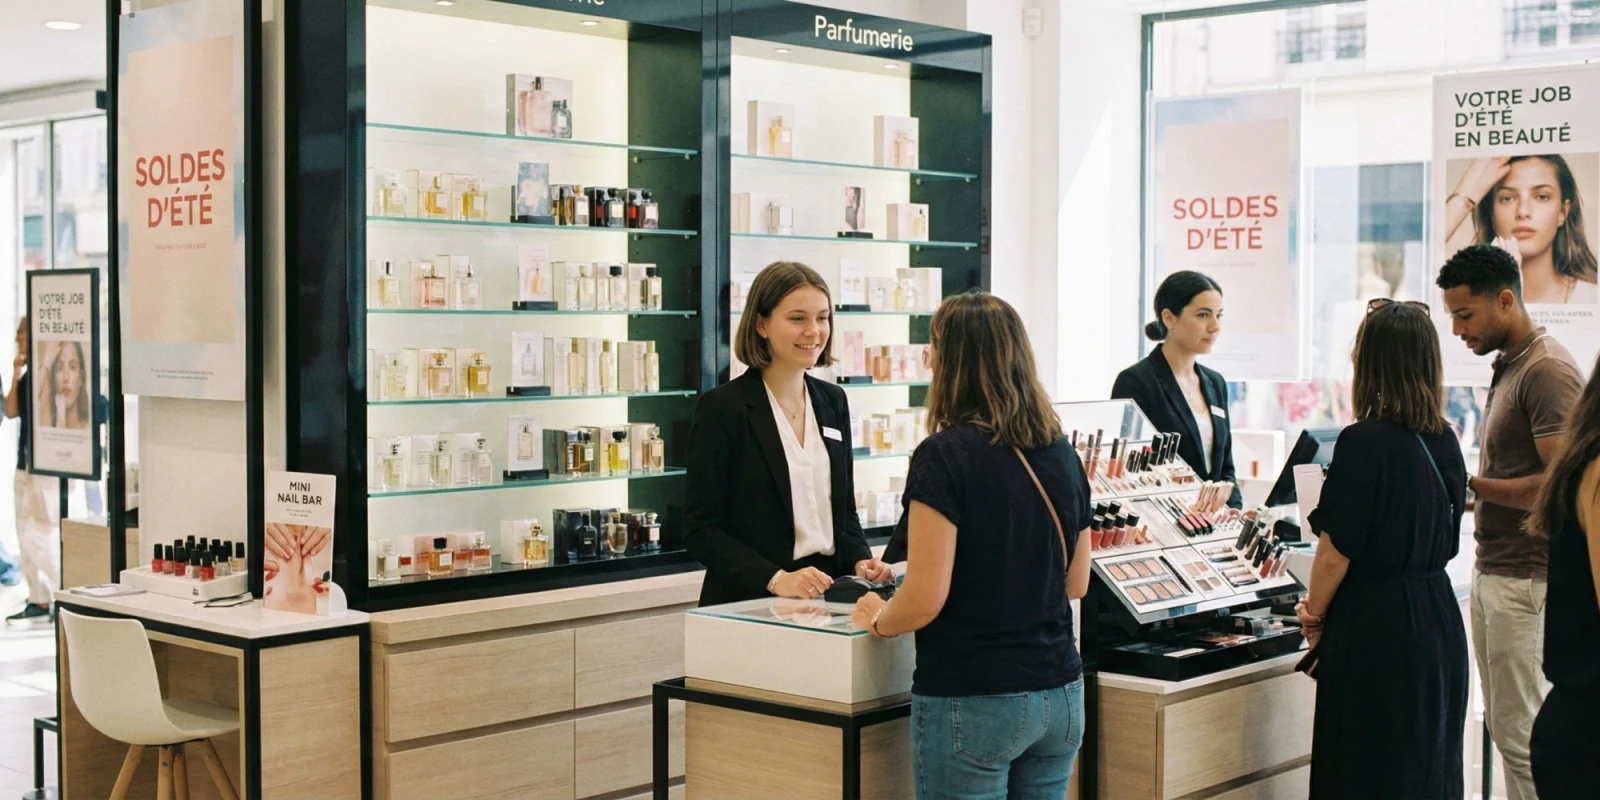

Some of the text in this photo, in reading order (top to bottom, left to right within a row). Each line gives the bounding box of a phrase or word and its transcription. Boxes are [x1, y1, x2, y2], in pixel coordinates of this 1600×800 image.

[815, 15, 913, 51] Parfumerie
[1455, 86, 1571, 108] VOTRE JOB
[1455, 106, 1512, 128] D'ÉTÉ
[1455, 122, 1571, 147] EN BEAUTÉ
[135, 148, 225, 187] SOLDES
[147, 184, 212, 228] D'ÉTÉ
[1173, 195, 1278, 220] SOLDES
[1187, 220, 1262, 250] D'ÉTÉ
[39, 293, 84, 304] VOTRE JOB
[39, 319, 84, 334] EN BEAUTÉ
[289, 481, 311, 492] MINI
[277, 493, 322, 506] NAIL BAR
